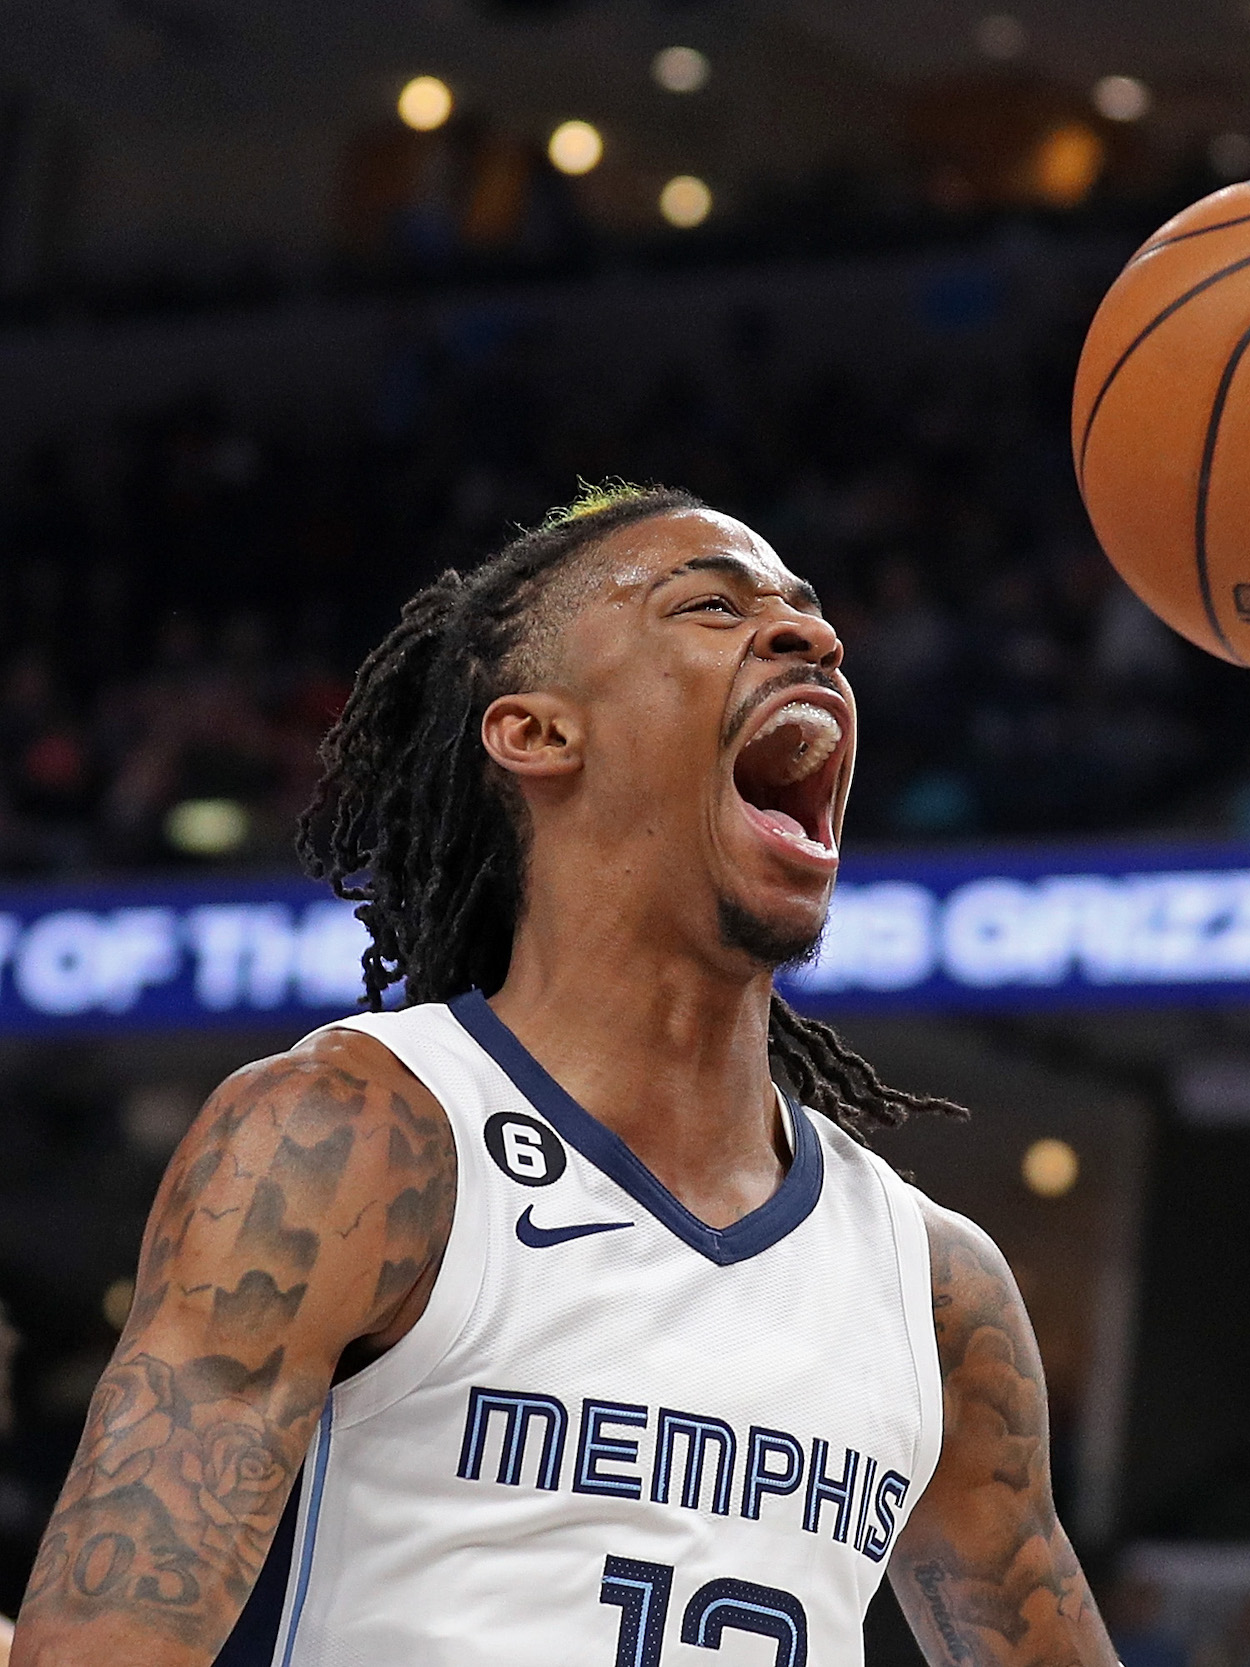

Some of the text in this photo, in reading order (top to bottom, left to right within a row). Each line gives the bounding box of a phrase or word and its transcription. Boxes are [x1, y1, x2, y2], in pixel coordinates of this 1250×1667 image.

[14, 908, 182, 1014] OF
[501, 1121, 548, 1178] 6
[456, 1385, 910, 1564] MEMPHIS
